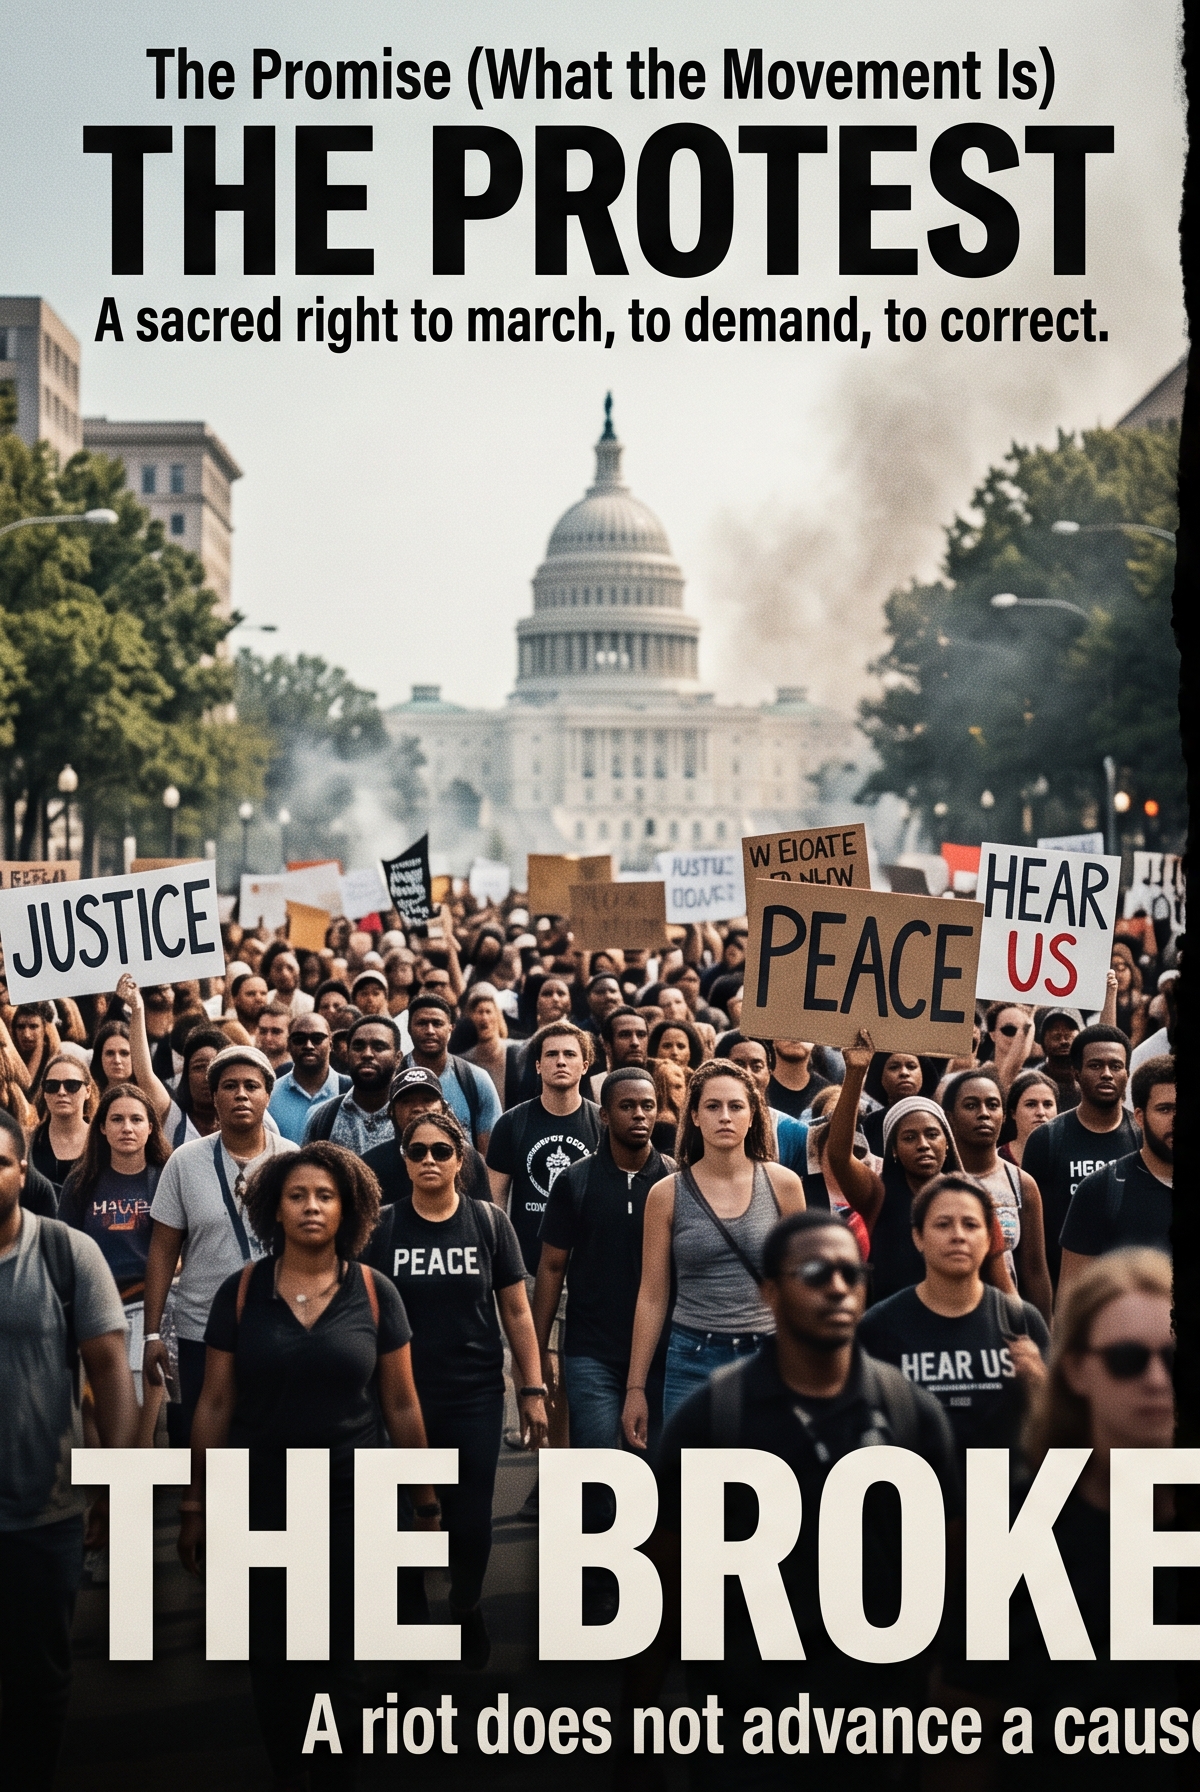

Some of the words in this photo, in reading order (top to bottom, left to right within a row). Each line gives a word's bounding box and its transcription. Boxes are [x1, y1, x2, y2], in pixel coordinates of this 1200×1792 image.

[12, 878, 216, 979] JUSTICE
[984, 852, 1110, 931] HEAR
[756, 904, 975, 1025] PEACE
[1007, 929, 1078, 998] US
[393, 1246, 480, 1277] PEACE
[901, 1349, 974, 1382] HEAR
[980, 1347, 1017, 1379] US
